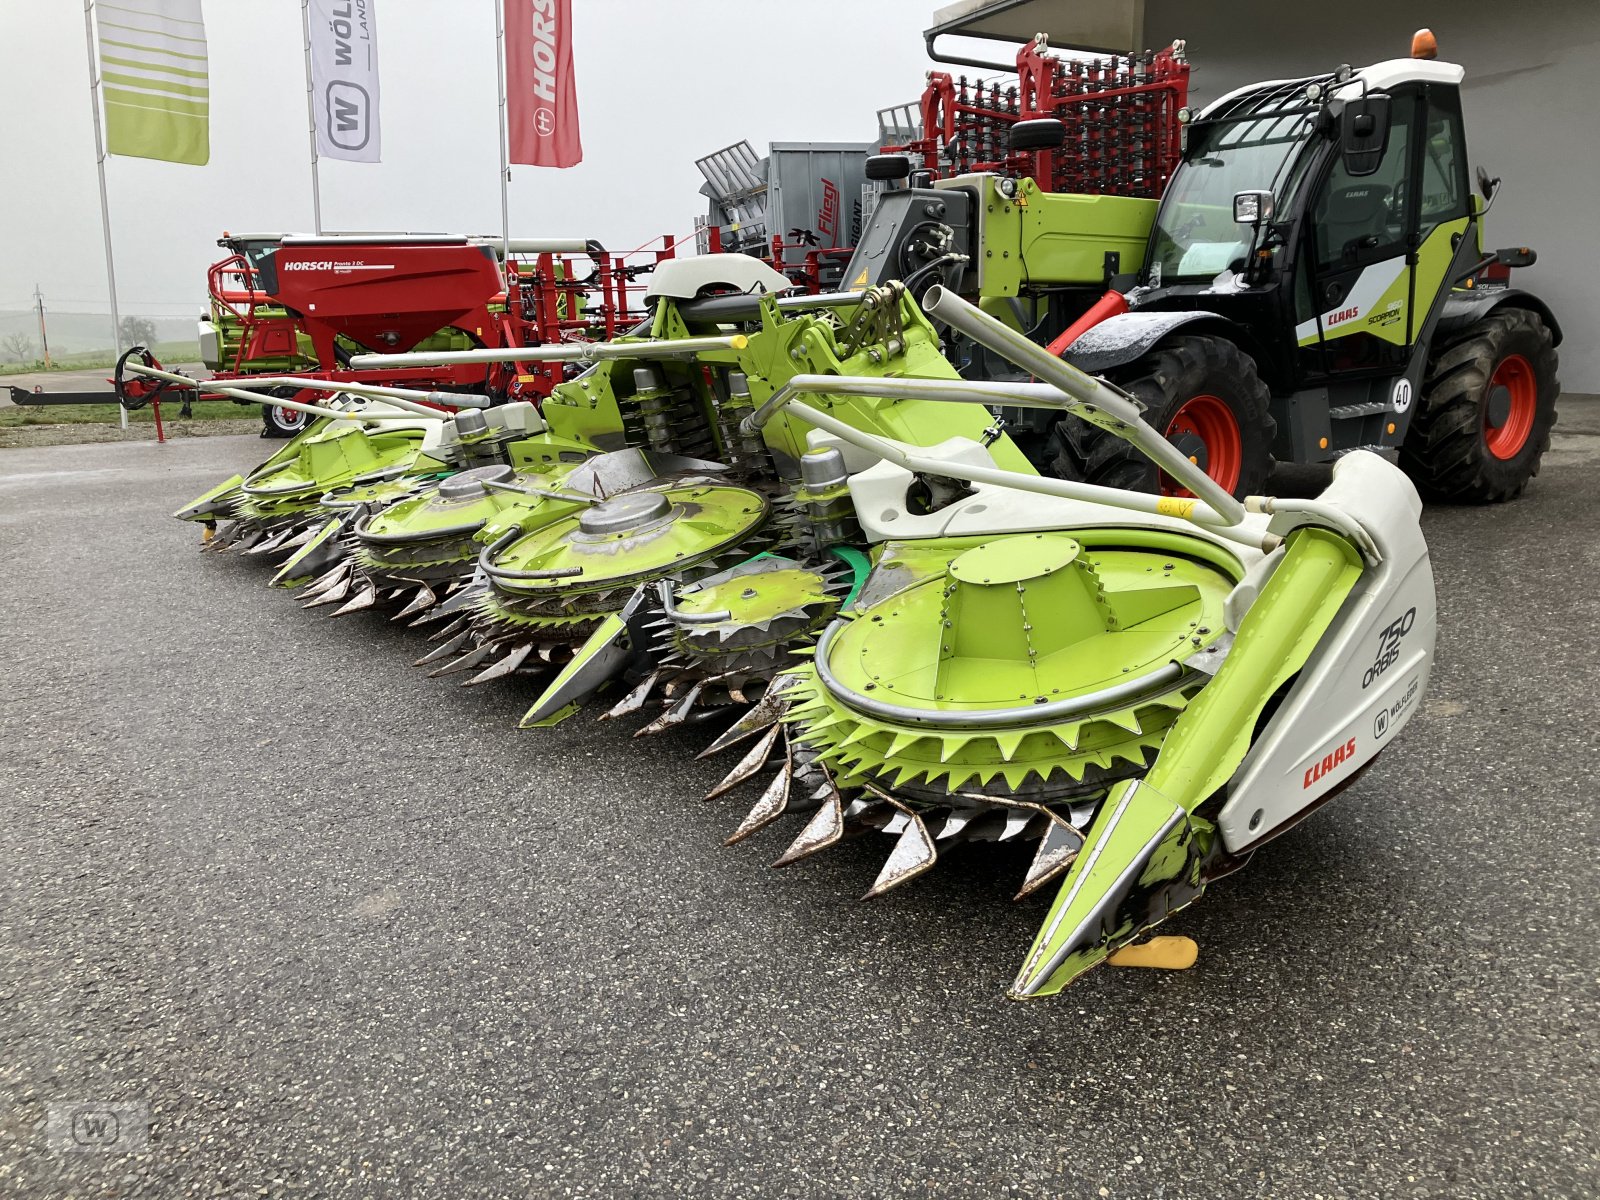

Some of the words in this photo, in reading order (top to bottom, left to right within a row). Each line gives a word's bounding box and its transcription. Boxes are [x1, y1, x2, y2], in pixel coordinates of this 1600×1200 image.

[329, 0, 352, 66] WÖL
[334, 96, 359, 132] W
[818, 177, 837, 236] Fliegl
[1345, 190, 1369, 198] CLAAS
[284, 261, 333, 271] HORSCH
[1328, 306, 1359, 326] CLAAS
[1368, 308, 1402, 326] SCORPION
[1395, 383, 1409, 406] 40
[1375, 606, 1417, 661] 750
[1361, 641, 1401, 690] ORBIS
[1390, 680, 1419, 718] WÖLFLEDER
[1303, 735, 1357, 790] CLAAS
